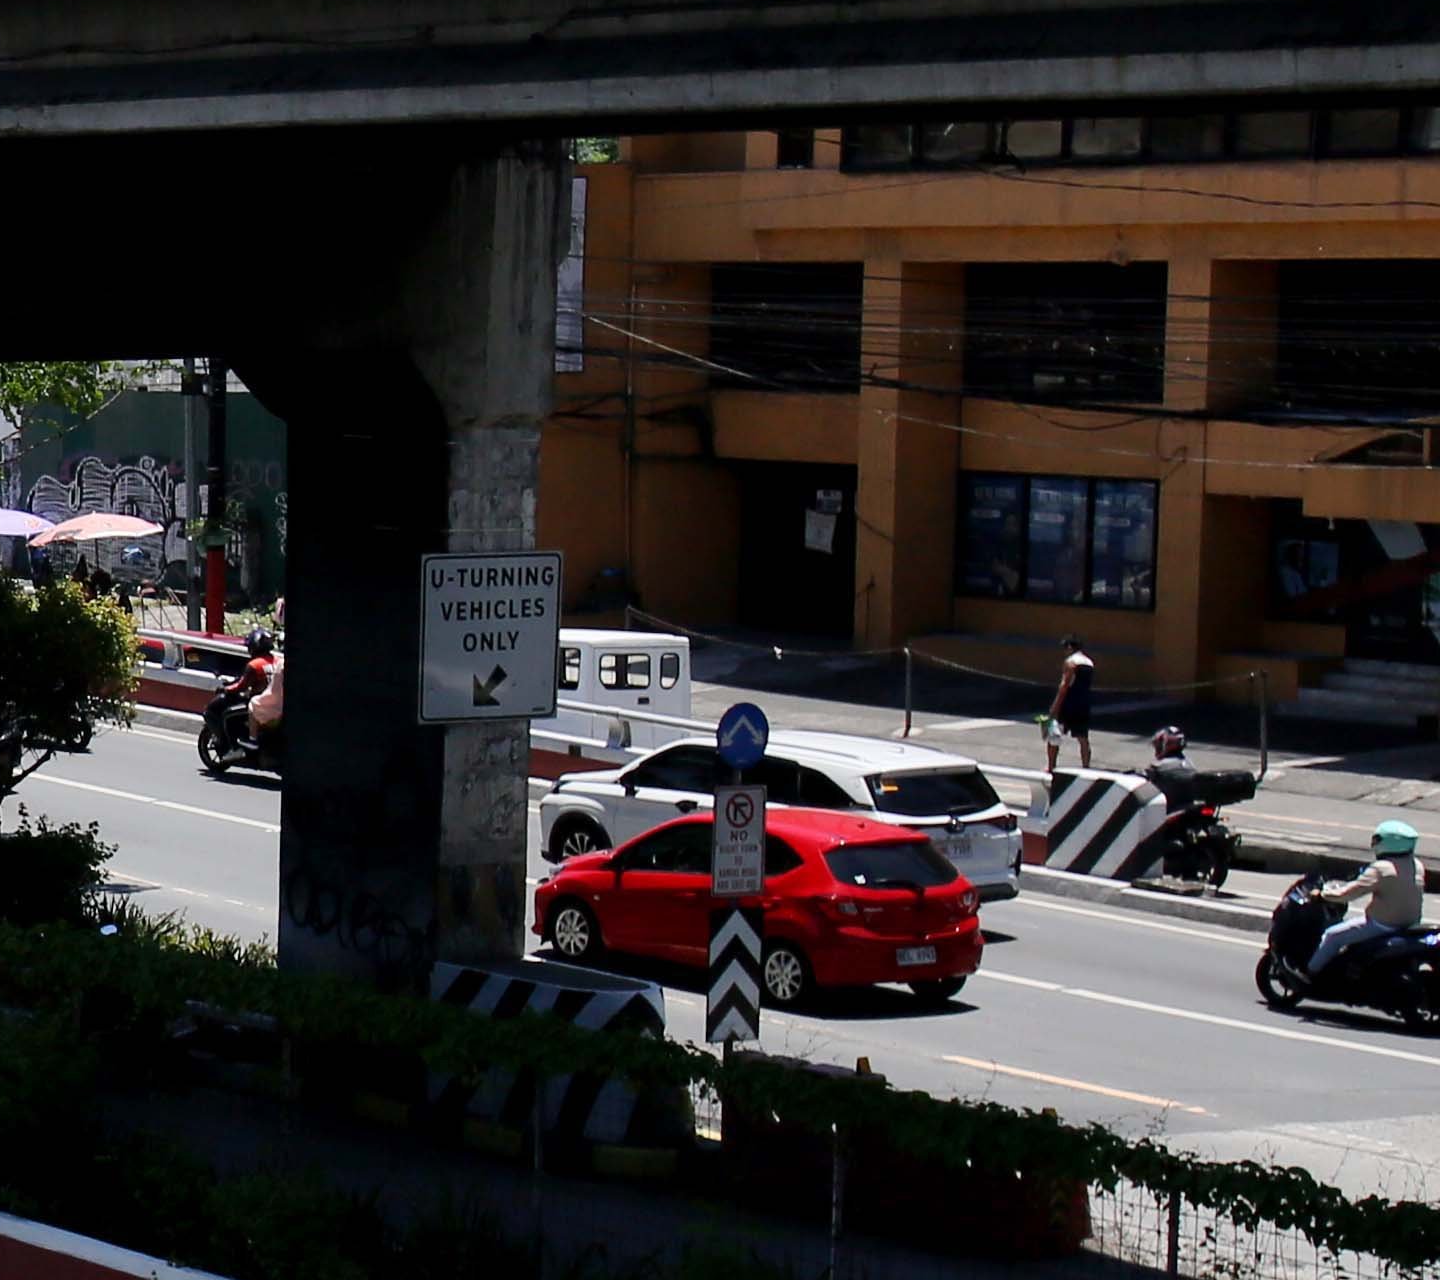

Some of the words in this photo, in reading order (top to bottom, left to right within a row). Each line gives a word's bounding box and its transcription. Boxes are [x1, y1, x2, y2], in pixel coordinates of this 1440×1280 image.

[431, 566, 555, 589] U-TURNING
[441, 598, 545, 621] VEHICLES
[462, 630, 520, 653] ONLY
[730, 830, 748, 841] NO
